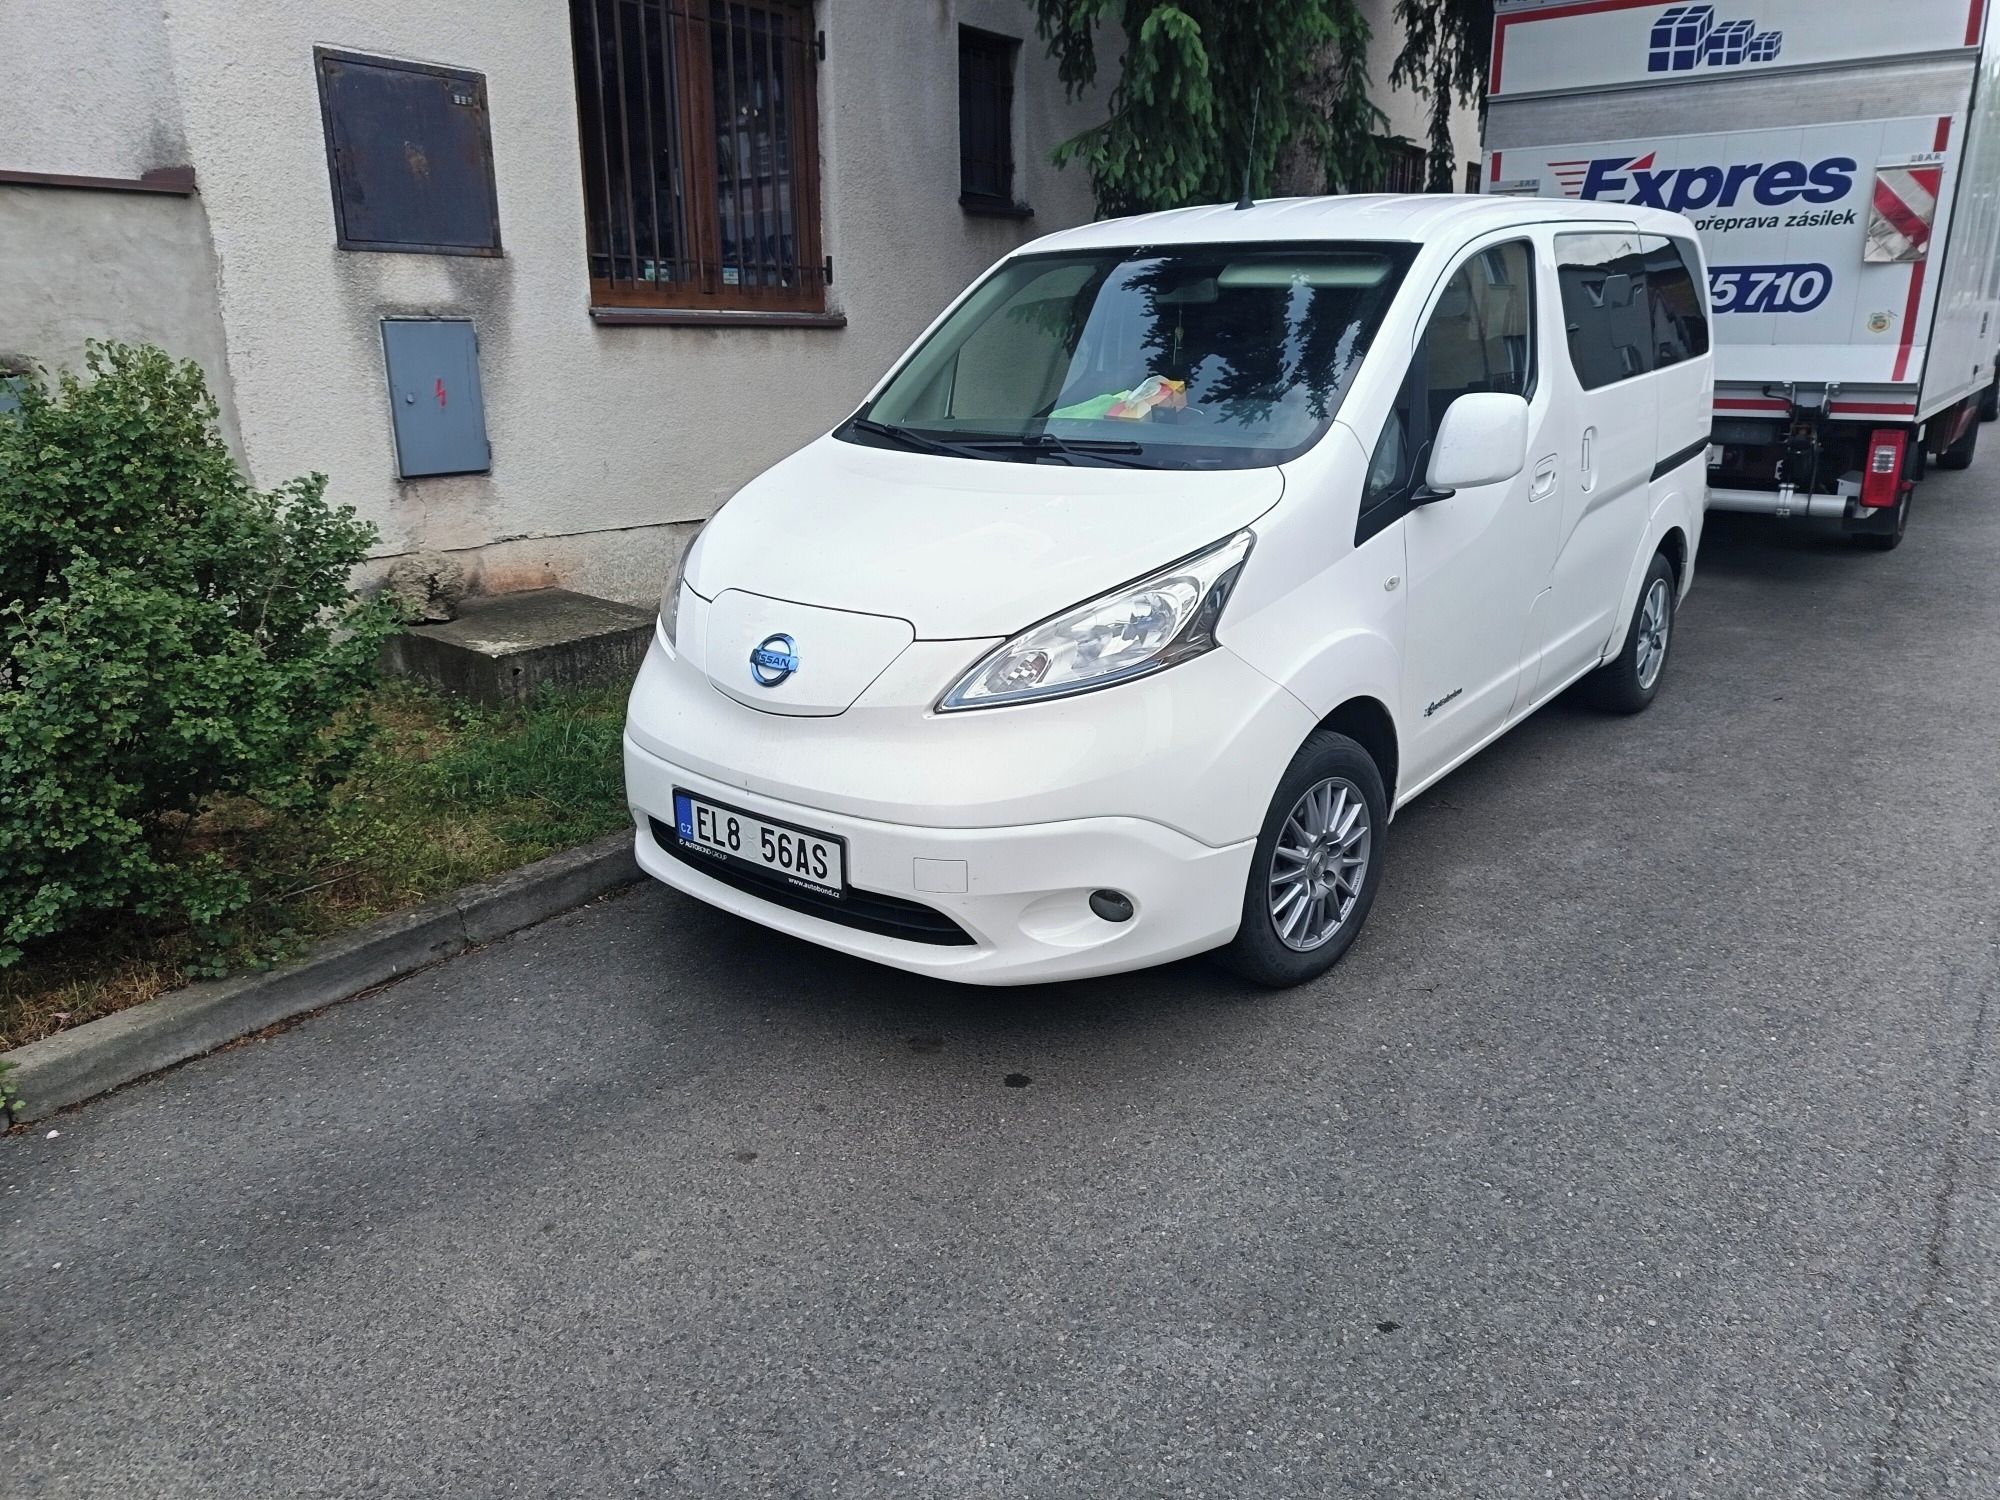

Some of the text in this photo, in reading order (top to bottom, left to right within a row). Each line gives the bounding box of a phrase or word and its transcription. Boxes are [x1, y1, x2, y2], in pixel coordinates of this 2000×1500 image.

[1579, 155, 1857, 213] Expres
[1695, 208, 1858, 232] přeprava zásilek
[753, 650, 790, 667] ISSAN
[681, 822, 692, 834] CZ
[697, 806, 827, 879] EL8 56AS
[788, 878, 840, 898] www.autobond.cz
